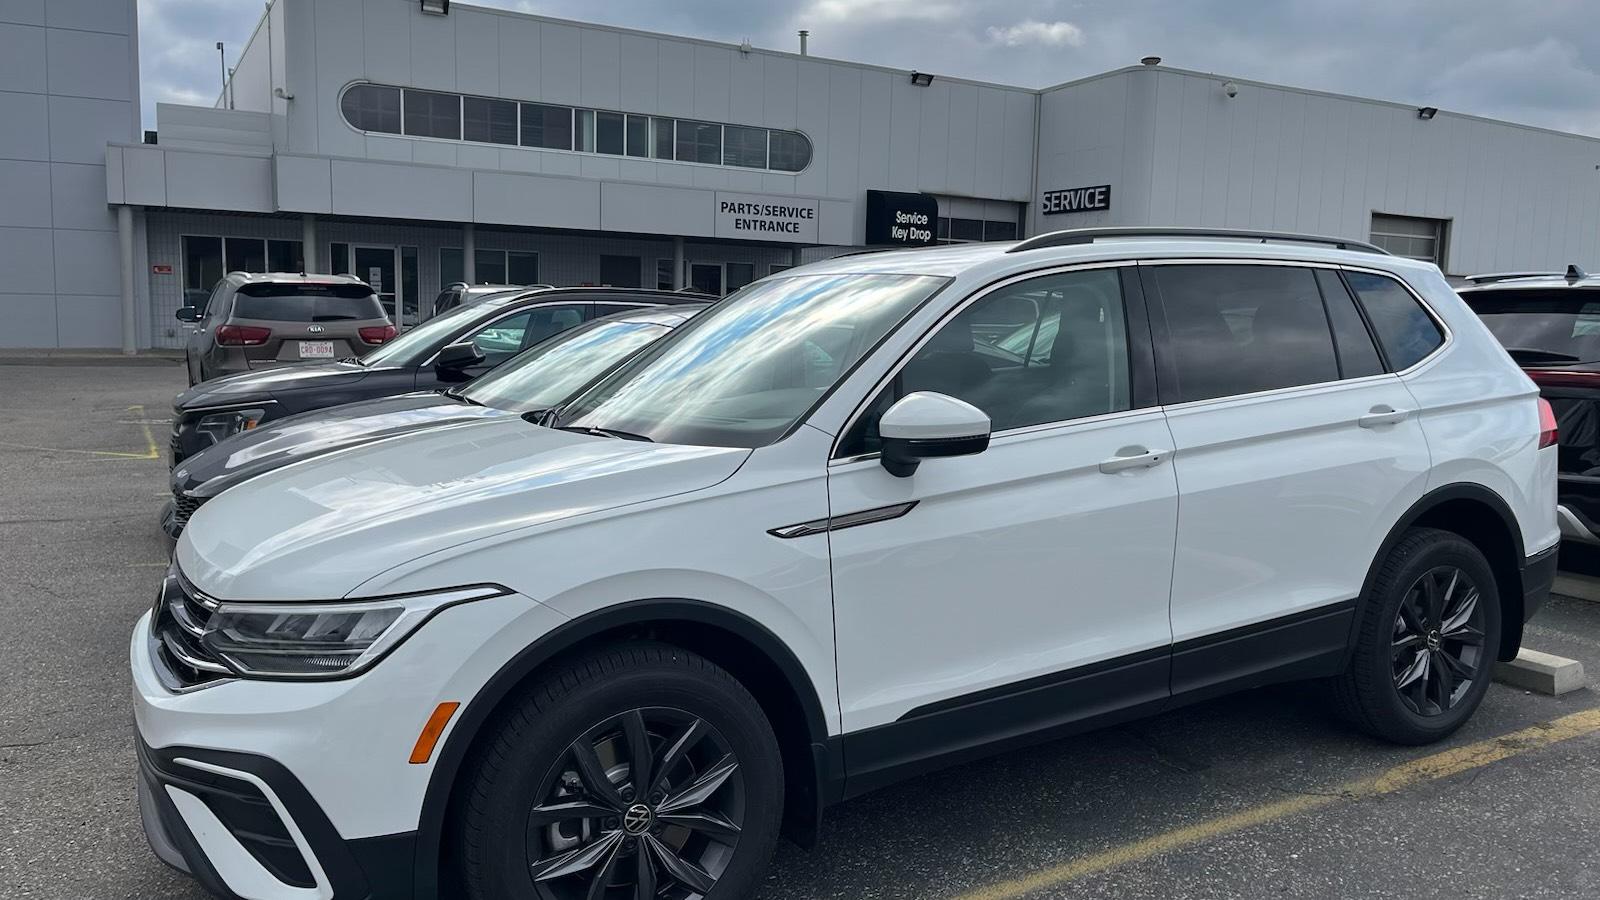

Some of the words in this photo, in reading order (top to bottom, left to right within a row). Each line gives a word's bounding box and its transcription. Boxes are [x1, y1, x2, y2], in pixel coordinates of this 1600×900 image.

[1043, 187, 1106, 213] SERVICE
[720, 201, 814, 219] PARTS/SERVICE
[896, 210, 928, 225] Service
[735, 218, 800, 234] ENTRANCE
[892, 226, 908, 241] Key
[909, 227, 931, 242] Drop
